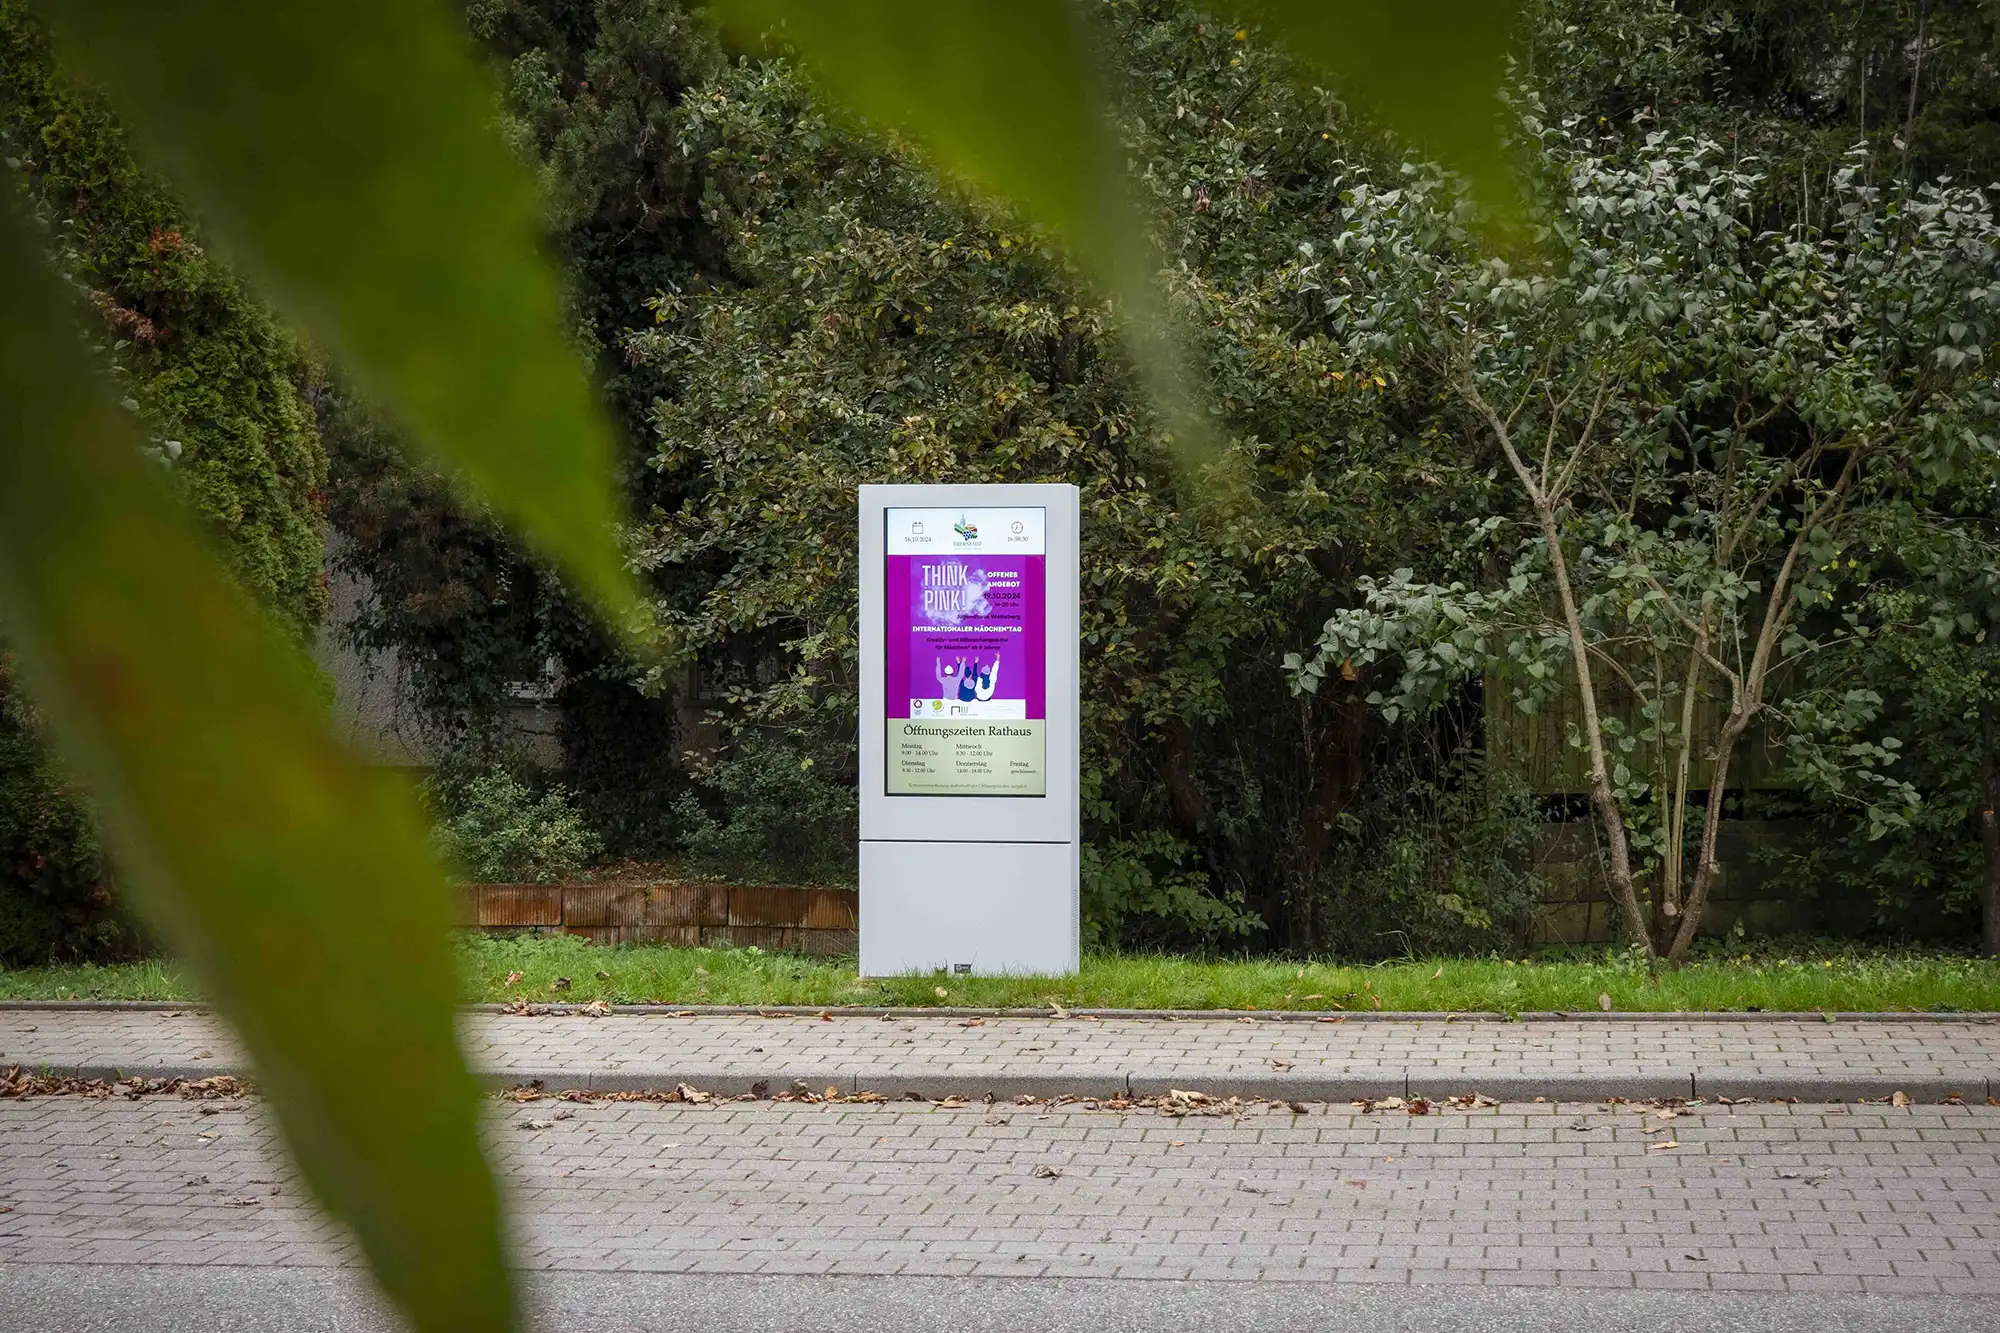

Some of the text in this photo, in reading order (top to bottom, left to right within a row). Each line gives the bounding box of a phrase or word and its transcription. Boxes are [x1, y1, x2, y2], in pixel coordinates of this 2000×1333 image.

[922, 565, 968, 586] THINK
[924, 590, 966, 610] PINK!
[904, 724, 1032, 739] Öffnungszeiten Rathaus
